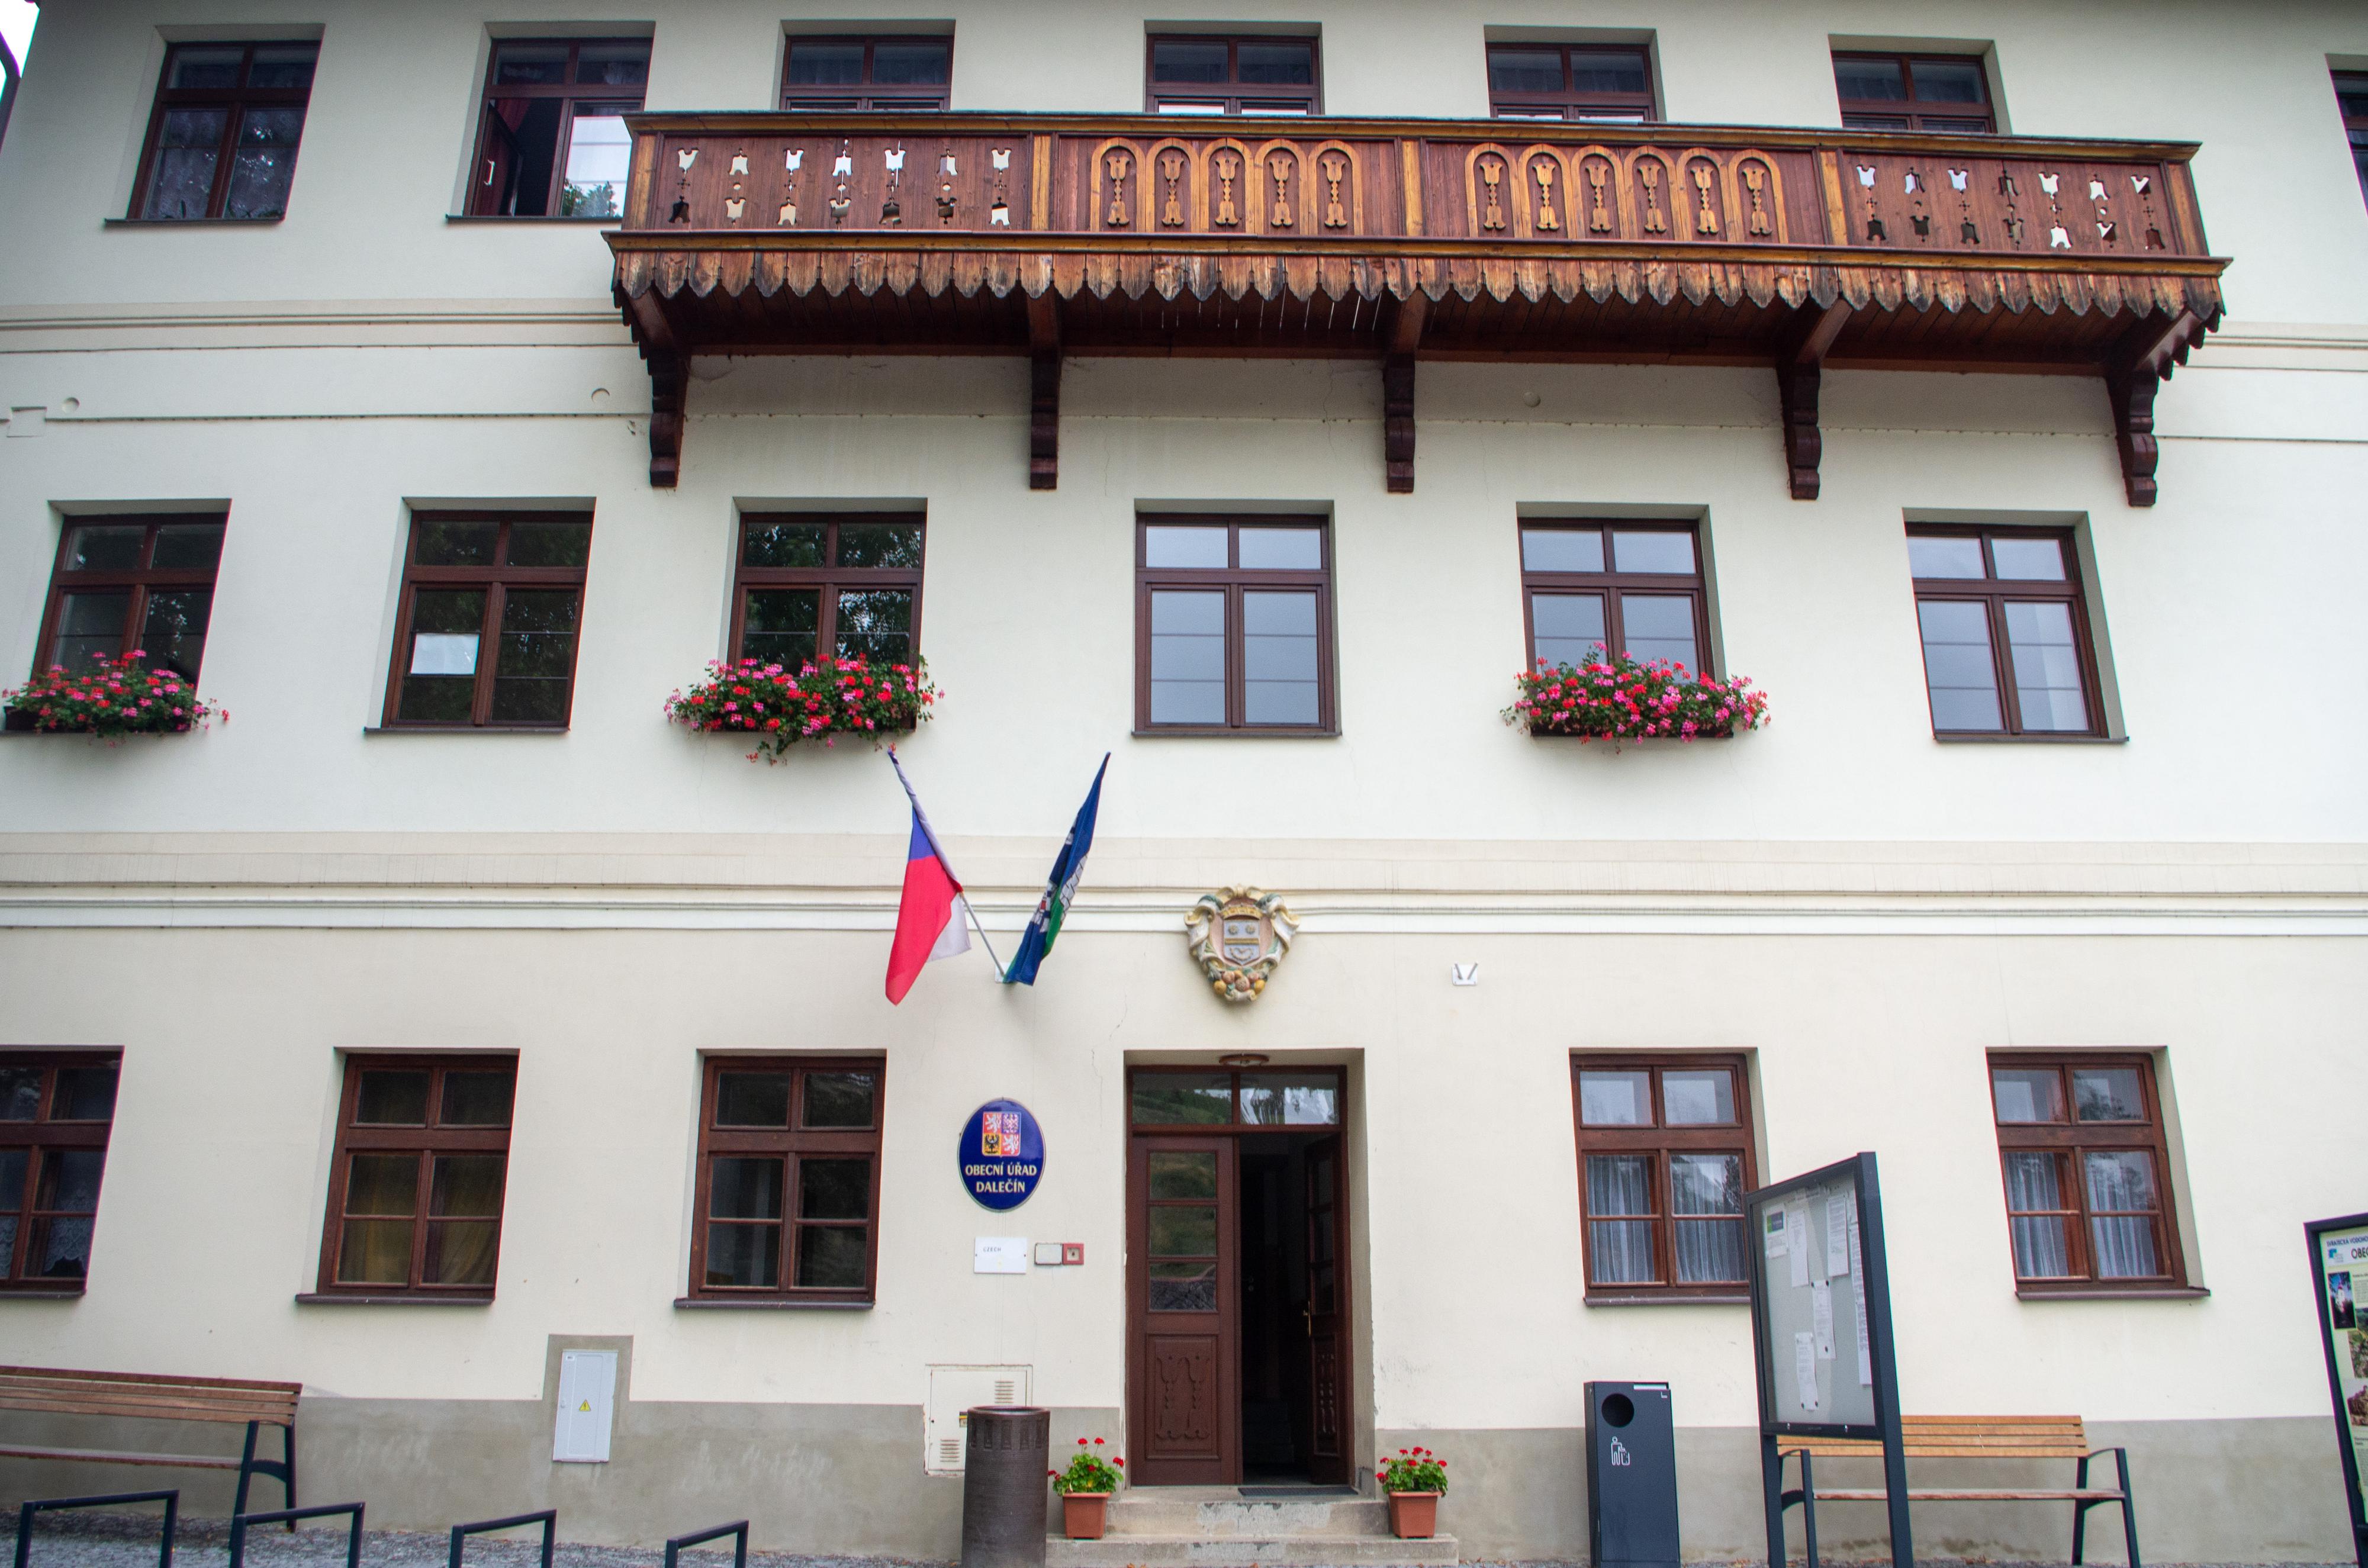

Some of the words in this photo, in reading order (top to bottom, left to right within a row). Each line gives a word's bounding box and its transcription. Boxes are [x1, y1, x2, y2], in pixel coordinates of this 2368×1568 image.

[965, 1161, 1004, 1176] OBECNÍ
[1007, 1161, 1037, 1176] ÚŘAD
[976, 1178, 1025, 1193] DALEČÍN
